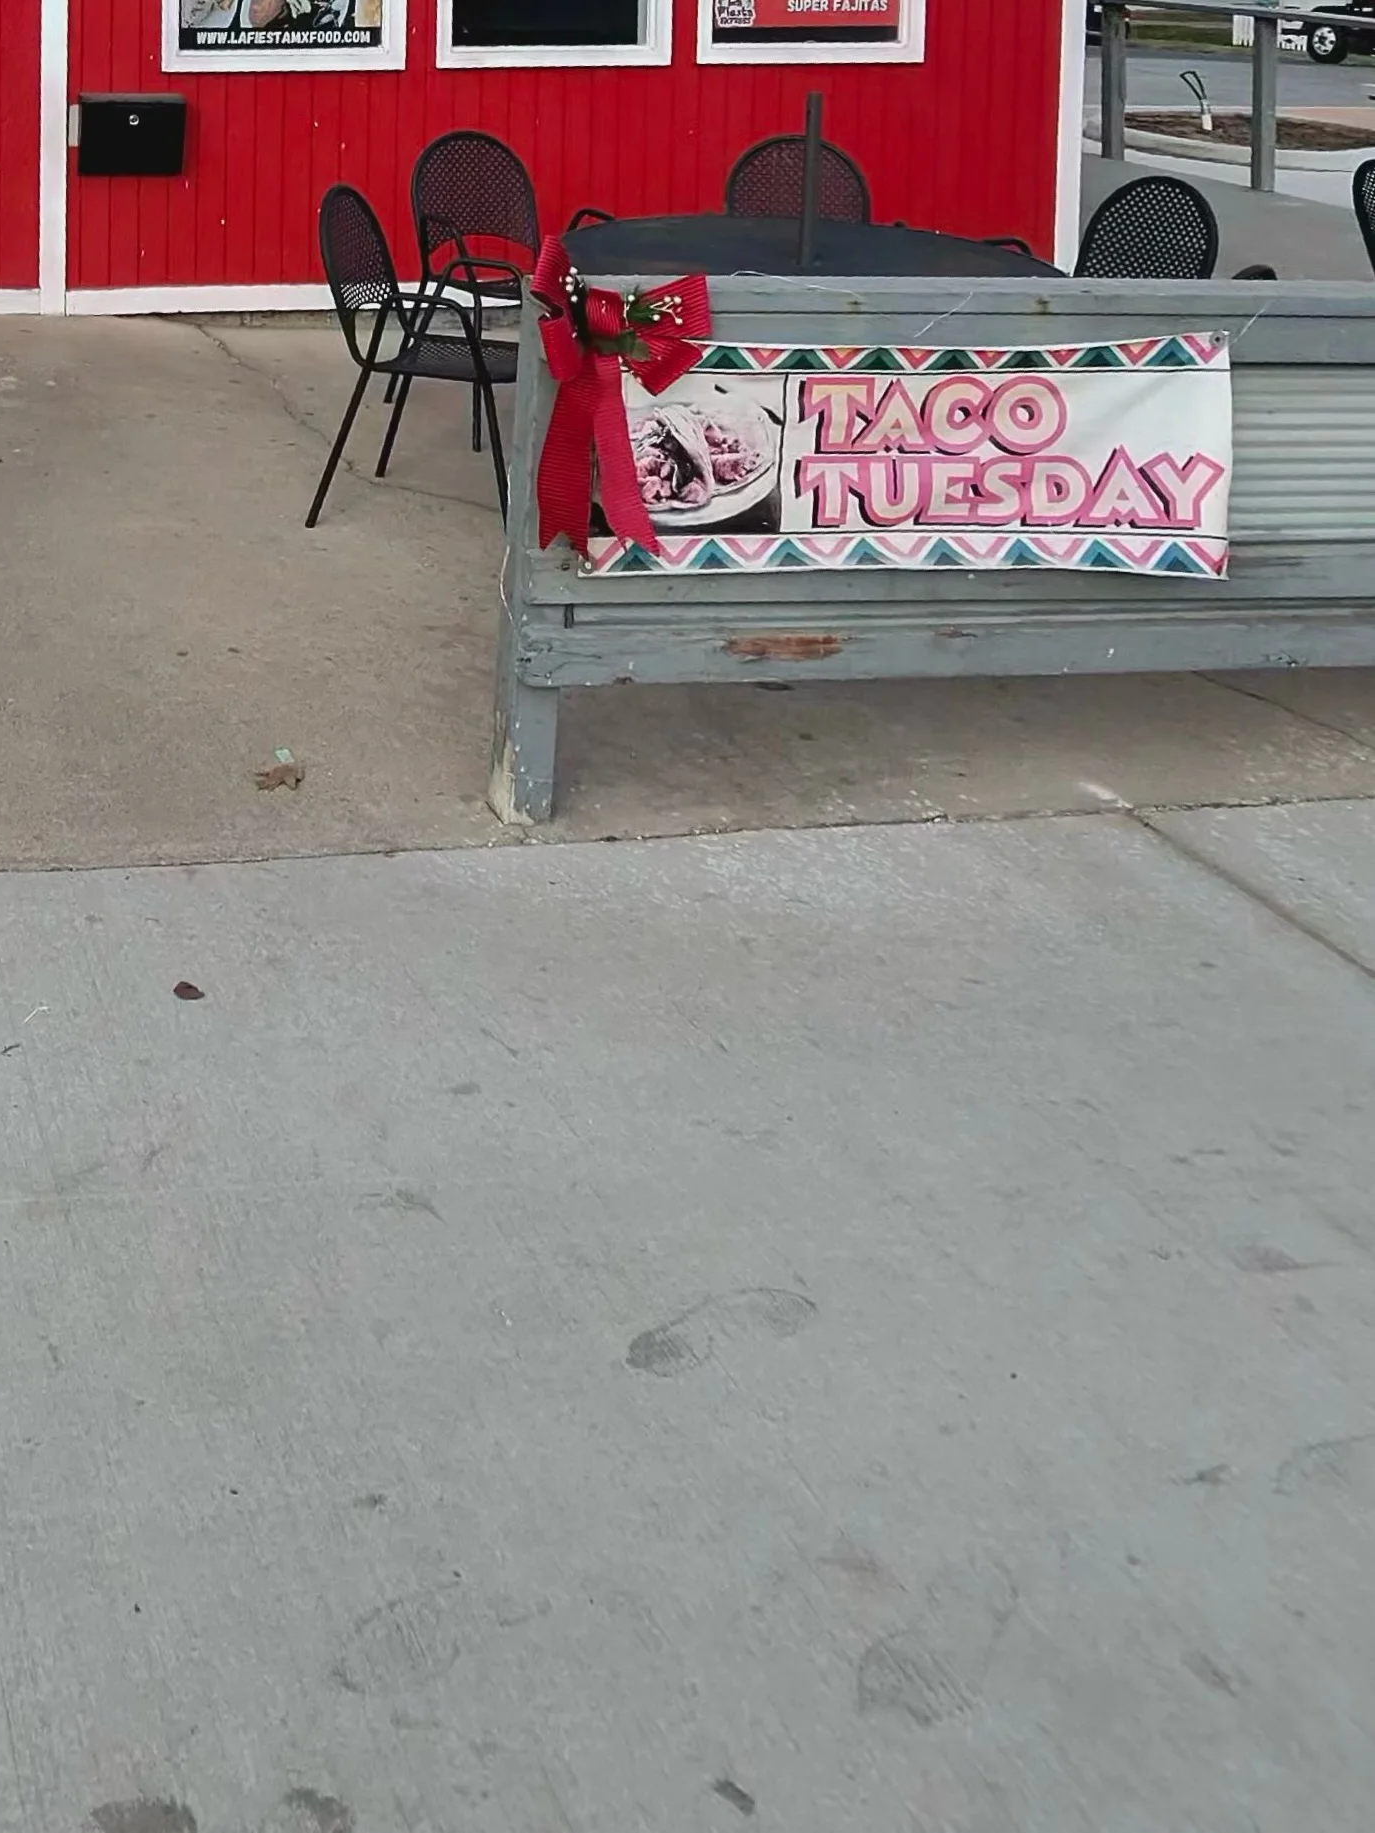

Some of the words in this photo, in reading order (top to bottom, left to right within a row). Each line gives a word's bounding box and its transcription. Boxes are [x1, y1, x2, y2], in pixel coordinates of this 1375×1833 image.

[196, 30, 371, 45] WWW.LAFIESTAMXFOOD.COM
[797, 375, 1069, 456] TACO
[797, 444, 1226, 530] TUESDAY
